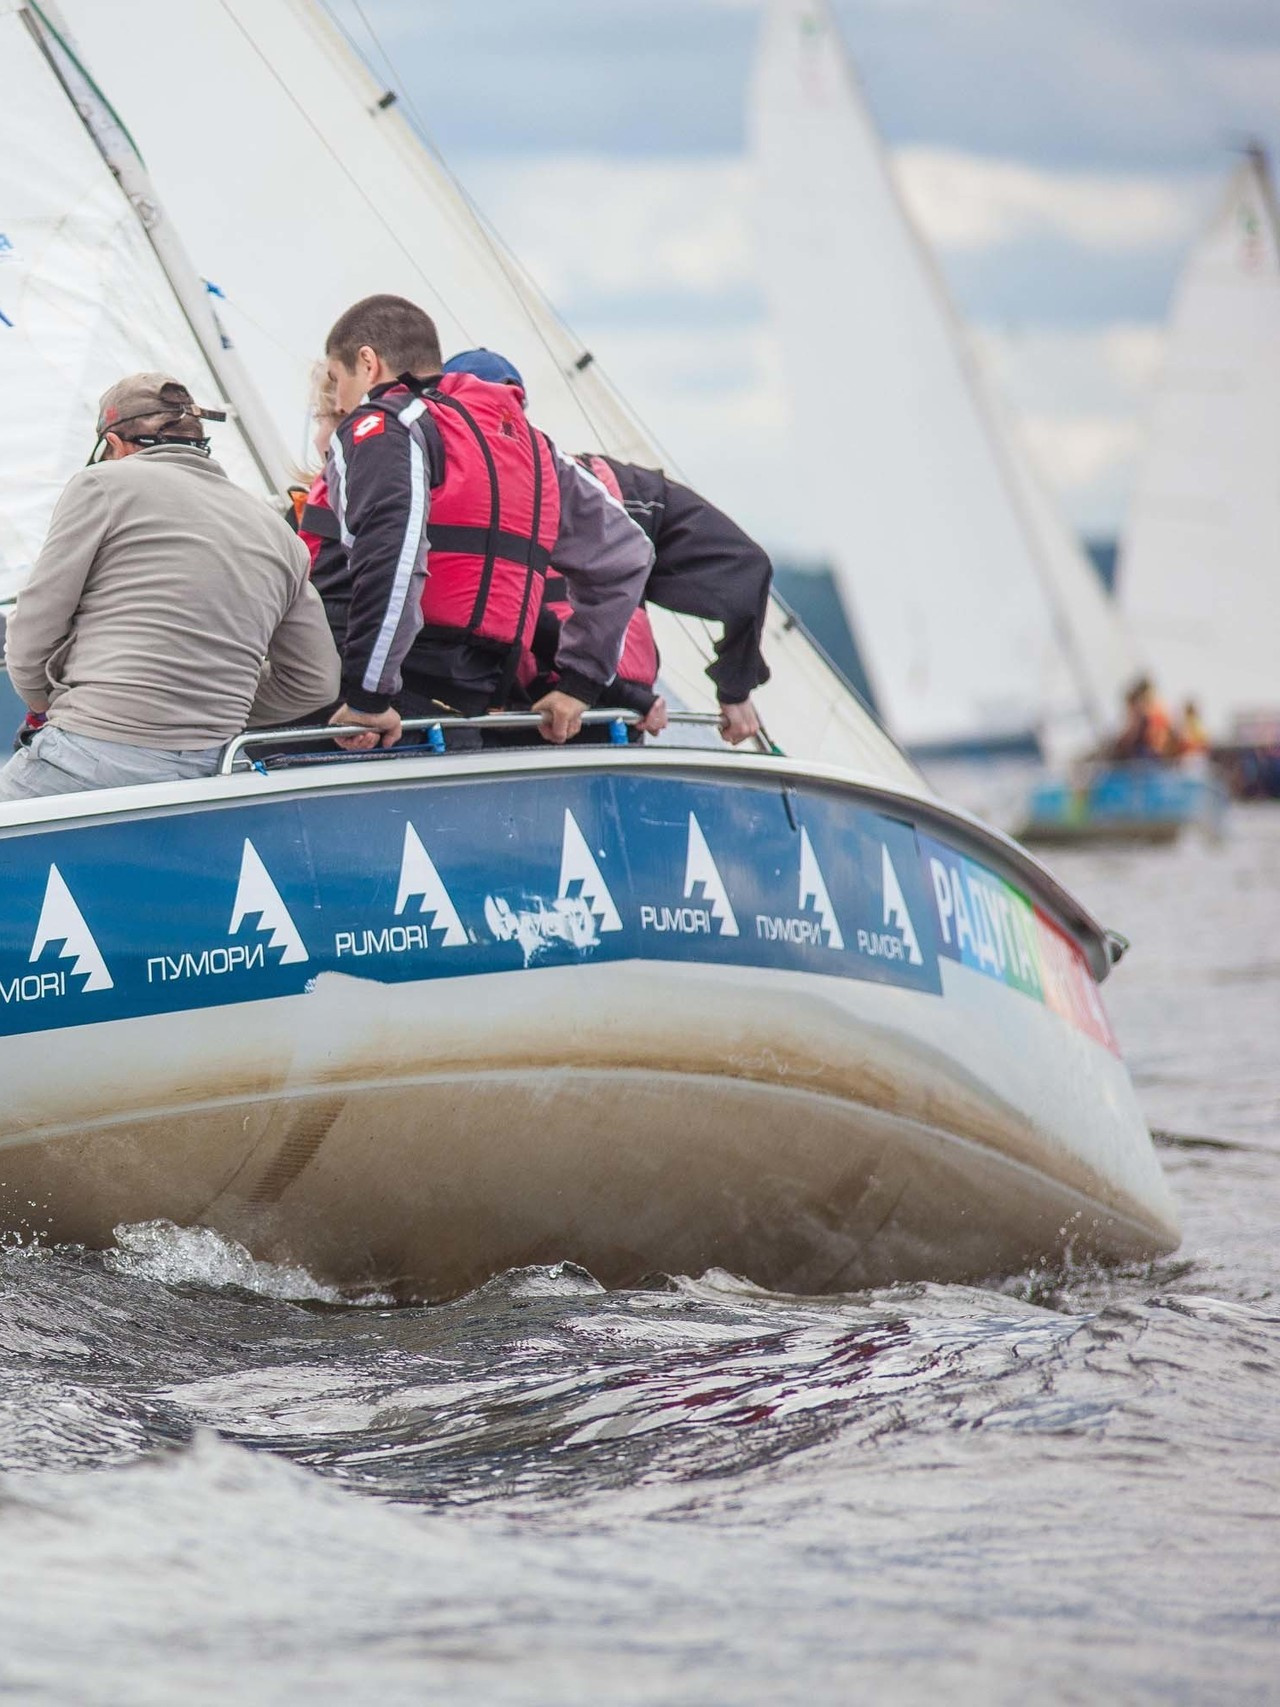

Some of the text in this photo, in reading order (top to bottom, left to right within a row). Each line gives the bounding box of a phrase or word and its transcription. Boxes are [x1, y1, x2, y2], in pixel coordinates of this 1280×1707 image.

[641, 905, 711, 933] PUMORI
[756, 914, 823, 946] ПУМОРИ
[335, 923, 429, 957] PUMORI
[147, 943, 264, 983] ПУМОРИ
